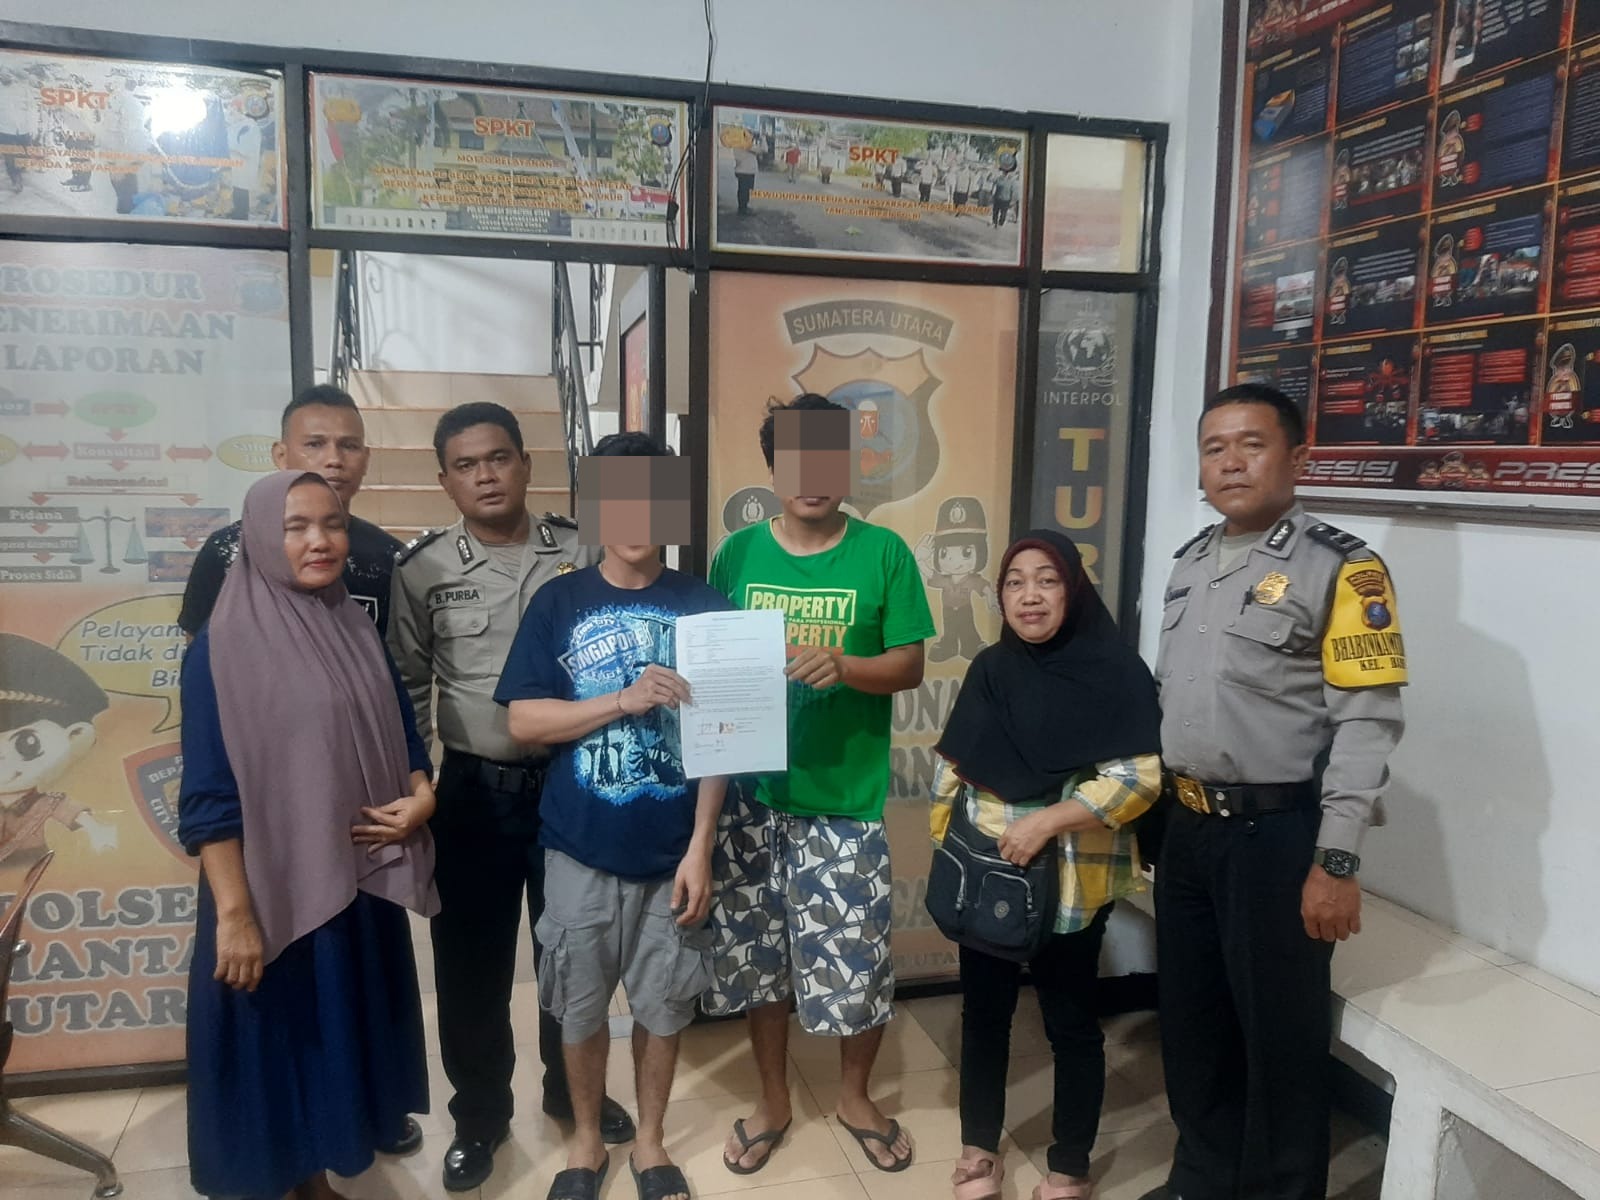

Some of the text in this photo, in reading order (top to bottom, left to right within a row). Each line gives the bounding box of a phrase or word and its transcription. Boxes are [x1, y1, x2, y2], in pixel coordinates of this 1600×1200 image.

[40, 87, 110, 111] SPKT
[474, 117, 535, 137] SPKT
[849, 146, 899, 165] SPKT
[793, 308, 945, 342] SUMATERA UTARA
[5, 344, 205, 375] LAPORAN
[1043, 391, 1124, 406] INTERPOL
[77, 446, 155, 457] Konsultasi
[9, 510, 63, 520] Pidana
[0, 569, 76, 580] Proses Sidik
[751, 591, 849, 619] PROPERTY
[80, 644, 153, 662] Tidak
[567, 625, 649, 674] SINGAPORE
